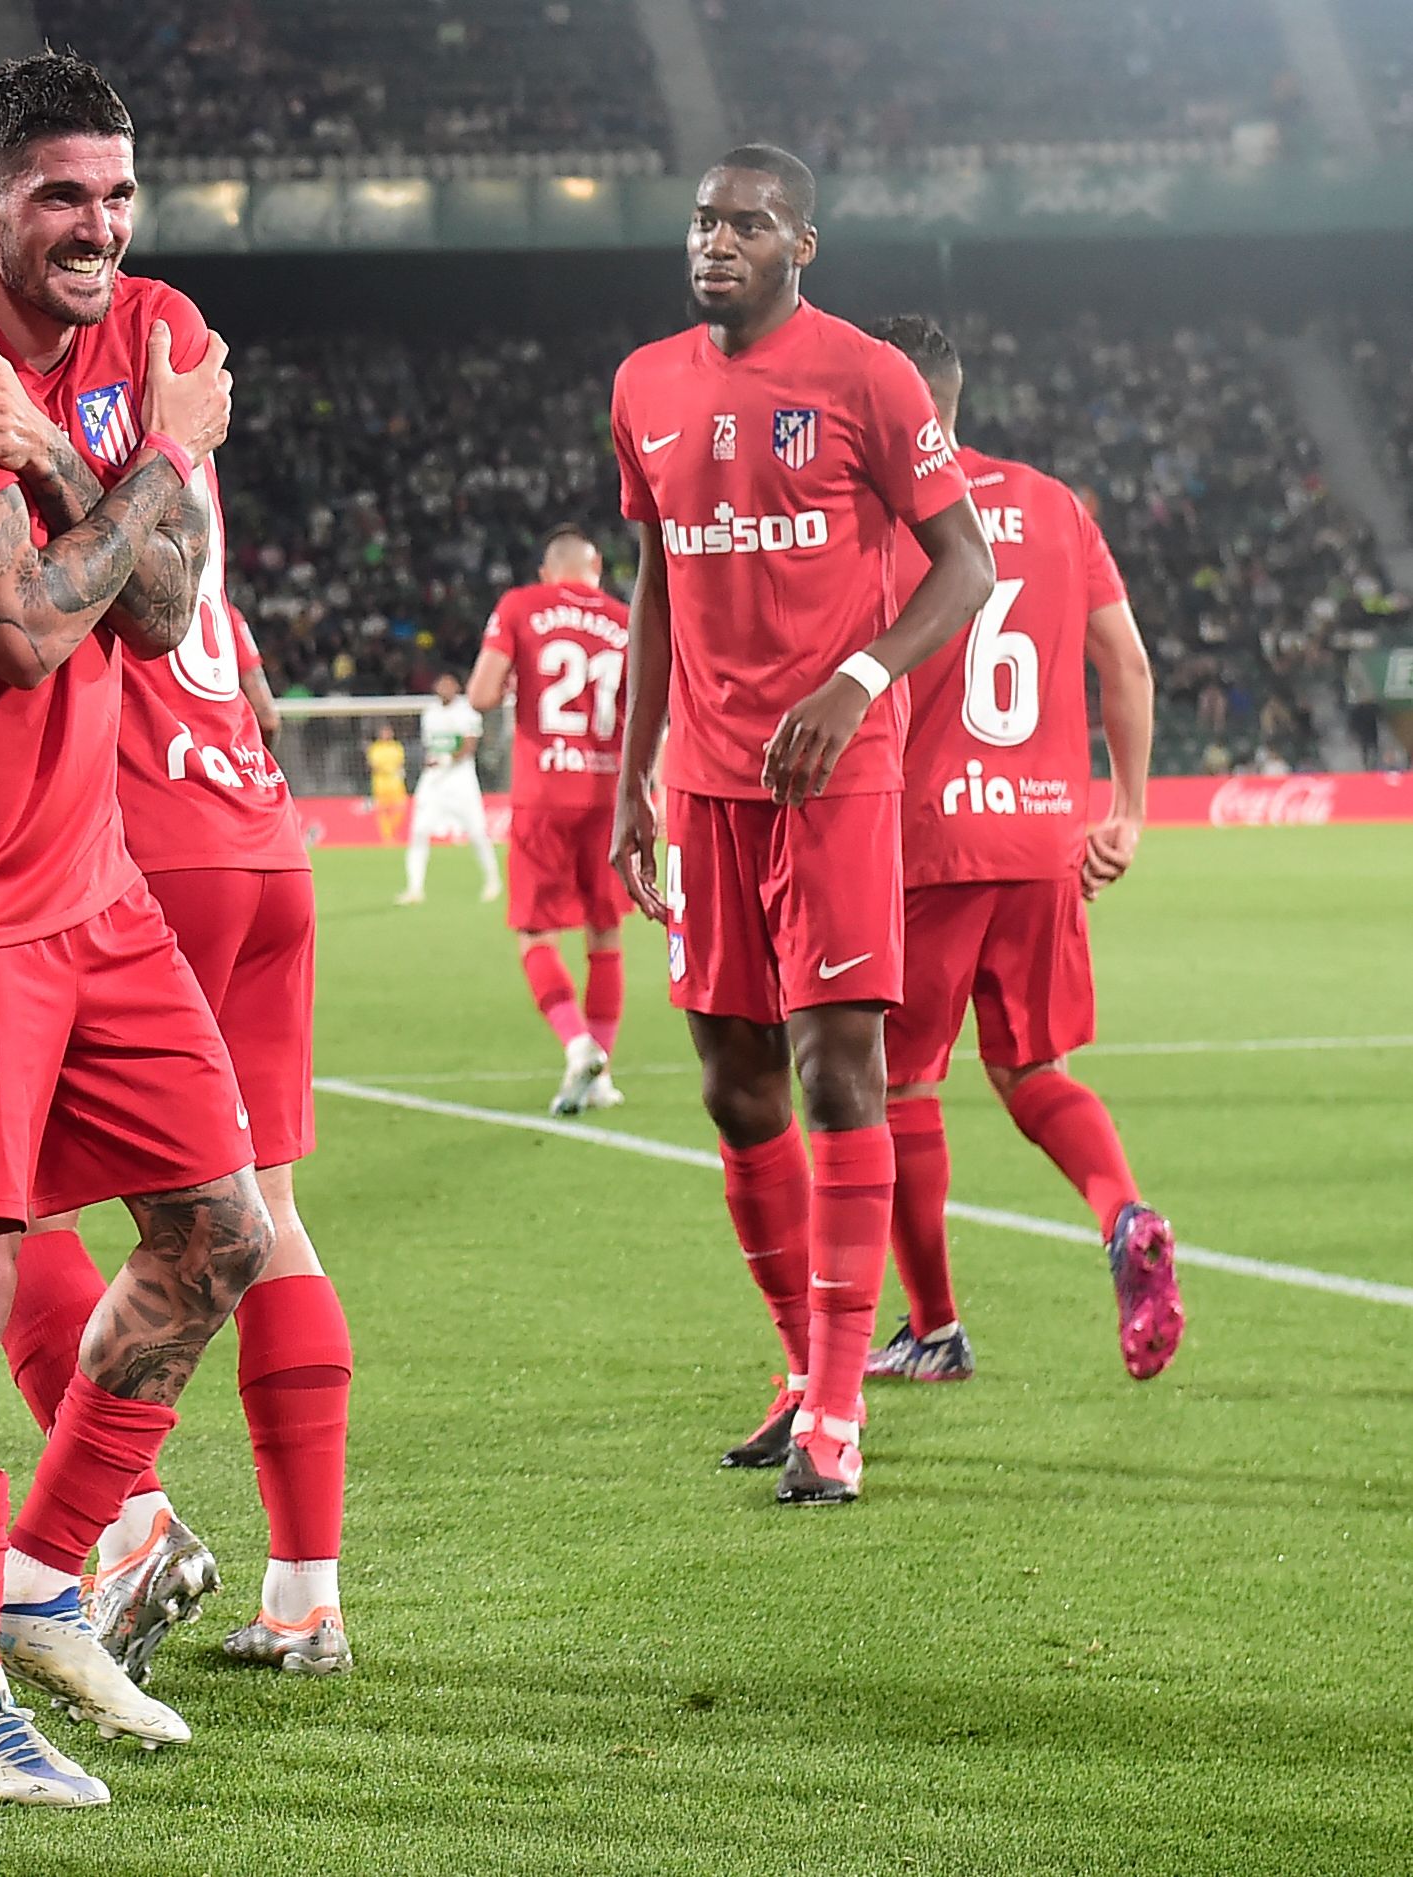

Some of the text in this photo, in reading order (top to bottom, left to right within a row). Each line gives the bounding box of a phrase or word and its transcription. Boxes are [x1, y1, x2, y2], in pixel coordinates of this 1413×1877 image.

[713, 414, 736, 441] 75
[662, 502, 828, 556] lus500
[962, 578, 1039, 747] 6
[539, 638, 624, 741] 21
[540, 736, 586, 773] ria
[943, 758, 1017, 816] ria
[1019, 776, 1067, 798] Money
[1019, 796, 1073, 815] Transfer
